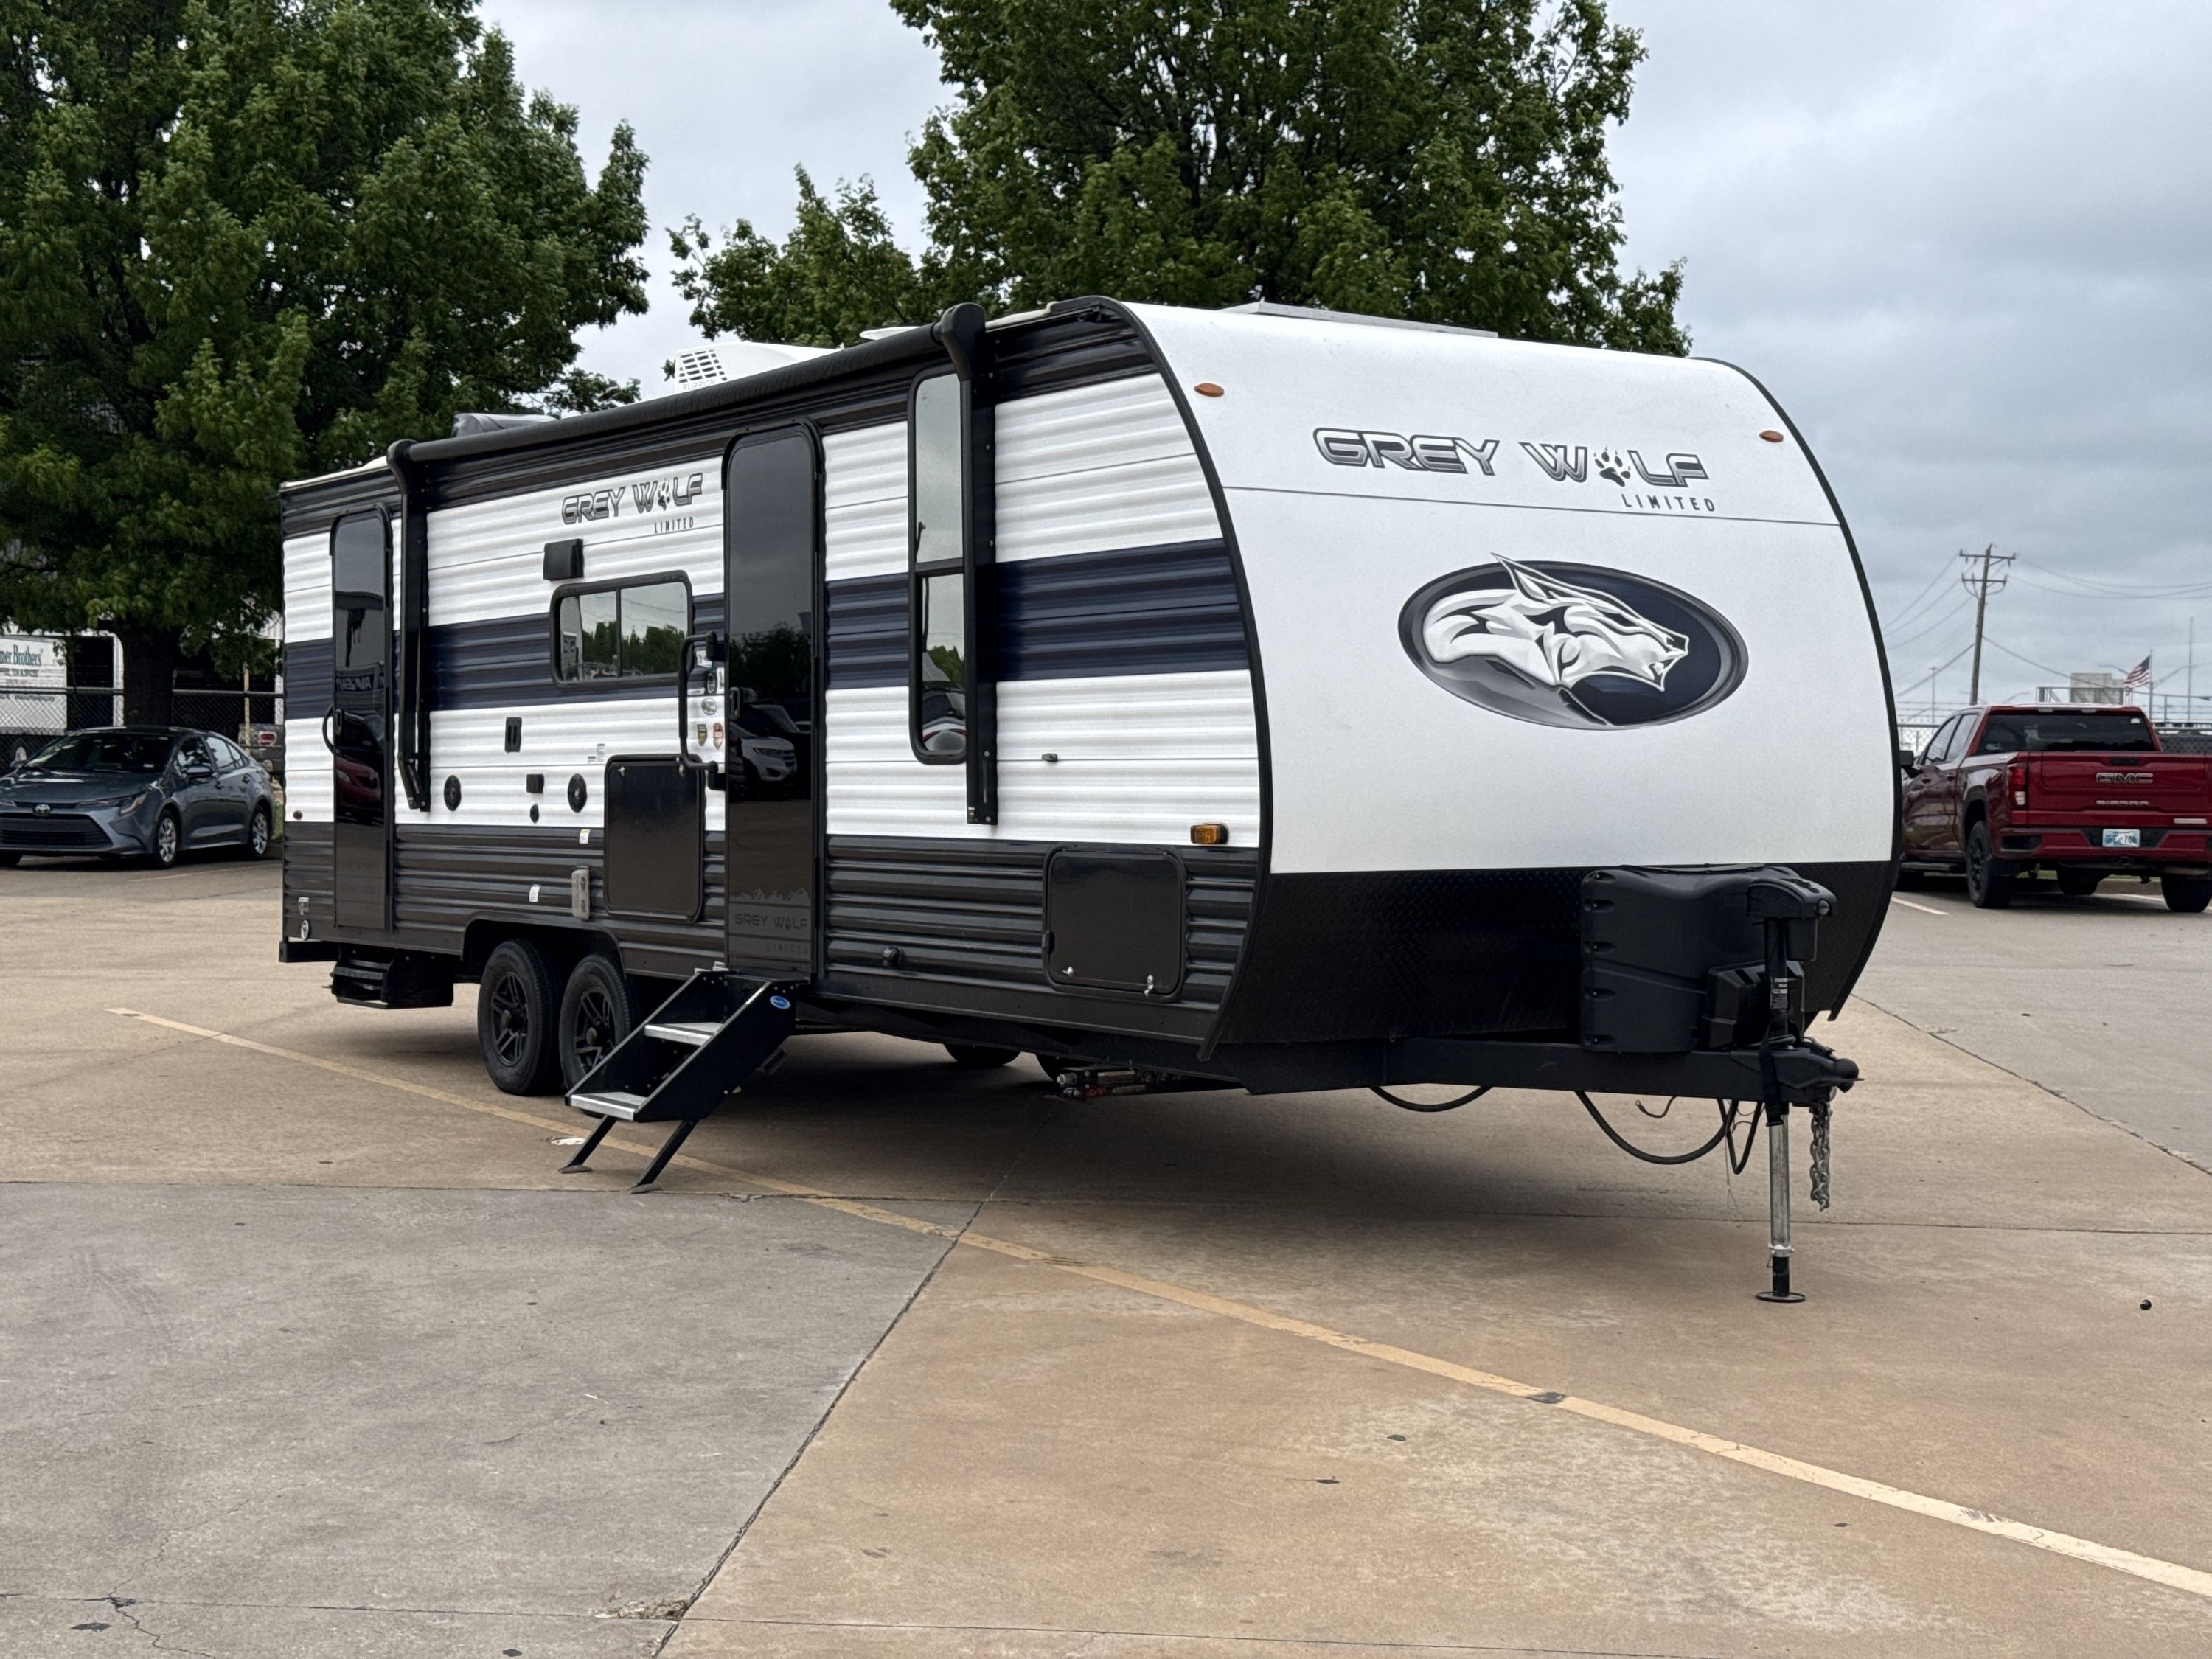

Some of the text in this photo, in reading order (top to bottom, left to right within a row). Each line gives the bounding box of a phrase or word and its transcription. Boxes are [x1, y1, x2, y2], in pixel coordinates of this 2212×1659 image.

[1312, 427, 1500, 476] GREY
[561, 486, 626, 525] GREY
[1621, 493, 1715, 512] LIMITED
[654, 516, 694, 533] LIMITED
[2096, 772, 2154, 784] GMC
[734, 913, 768, 926] GREY
